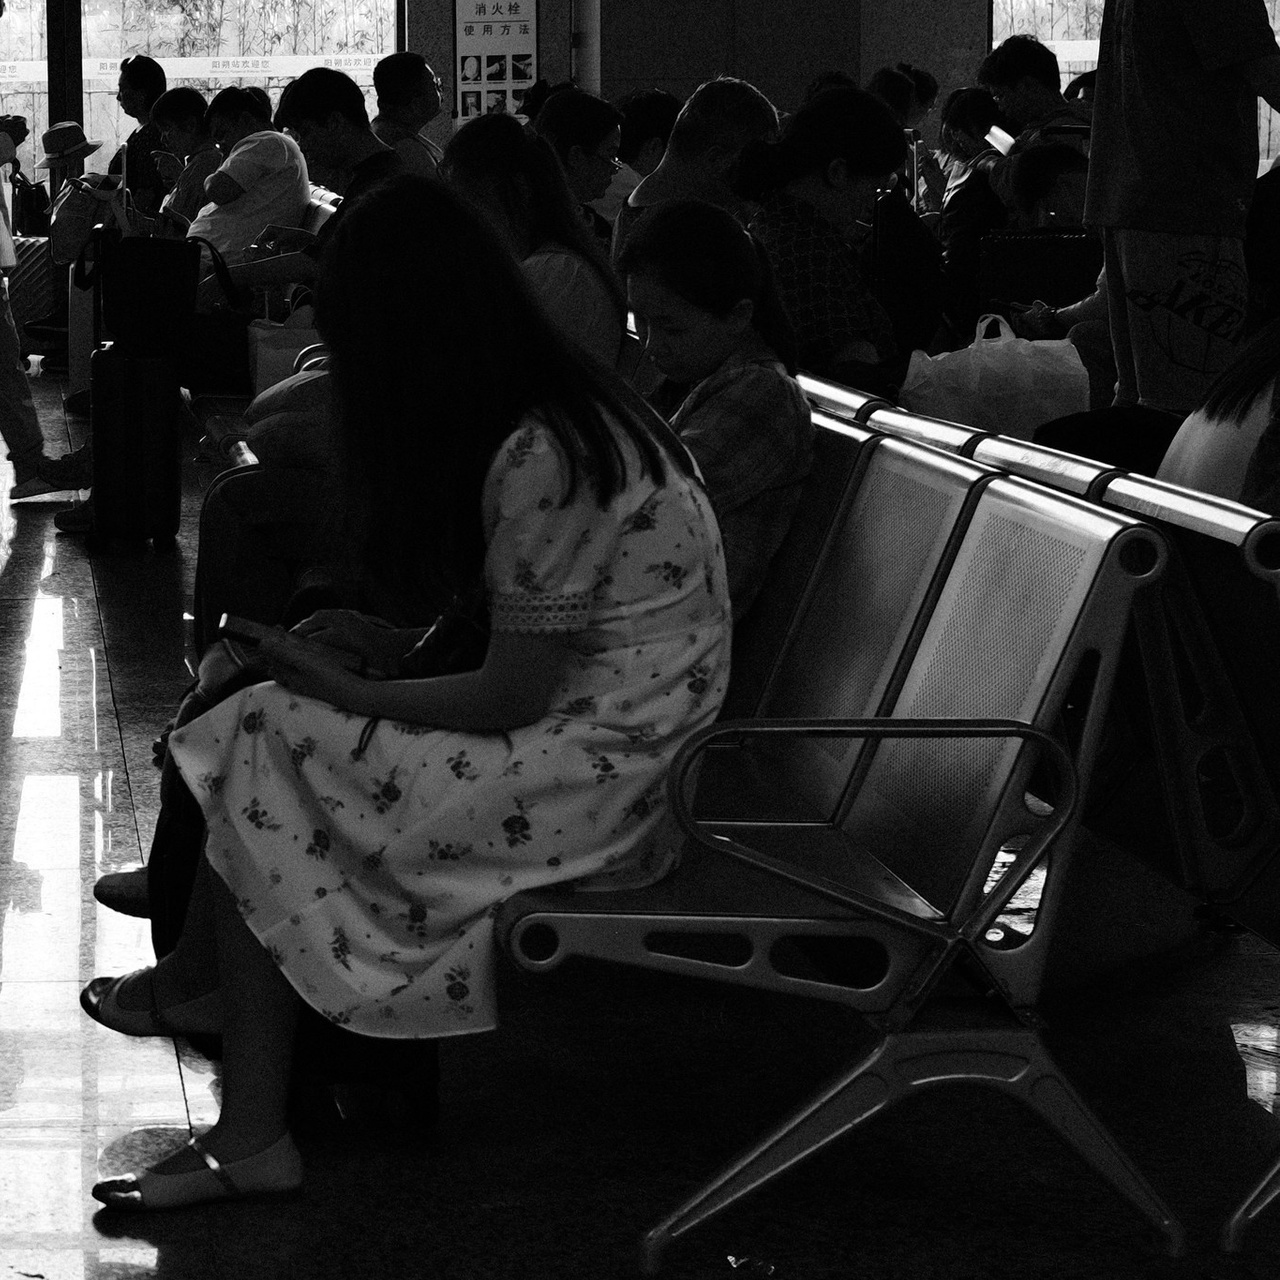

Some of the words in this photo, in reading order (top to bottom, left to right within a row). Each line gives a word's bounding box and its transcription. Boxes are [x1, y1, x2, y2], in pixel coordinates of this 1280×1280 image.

[475, 2, 521, 16] 消火栓
[464, 24, 530, 36] 使用方法
[211, 60, 271, 69] 阳朔站欢迎您
